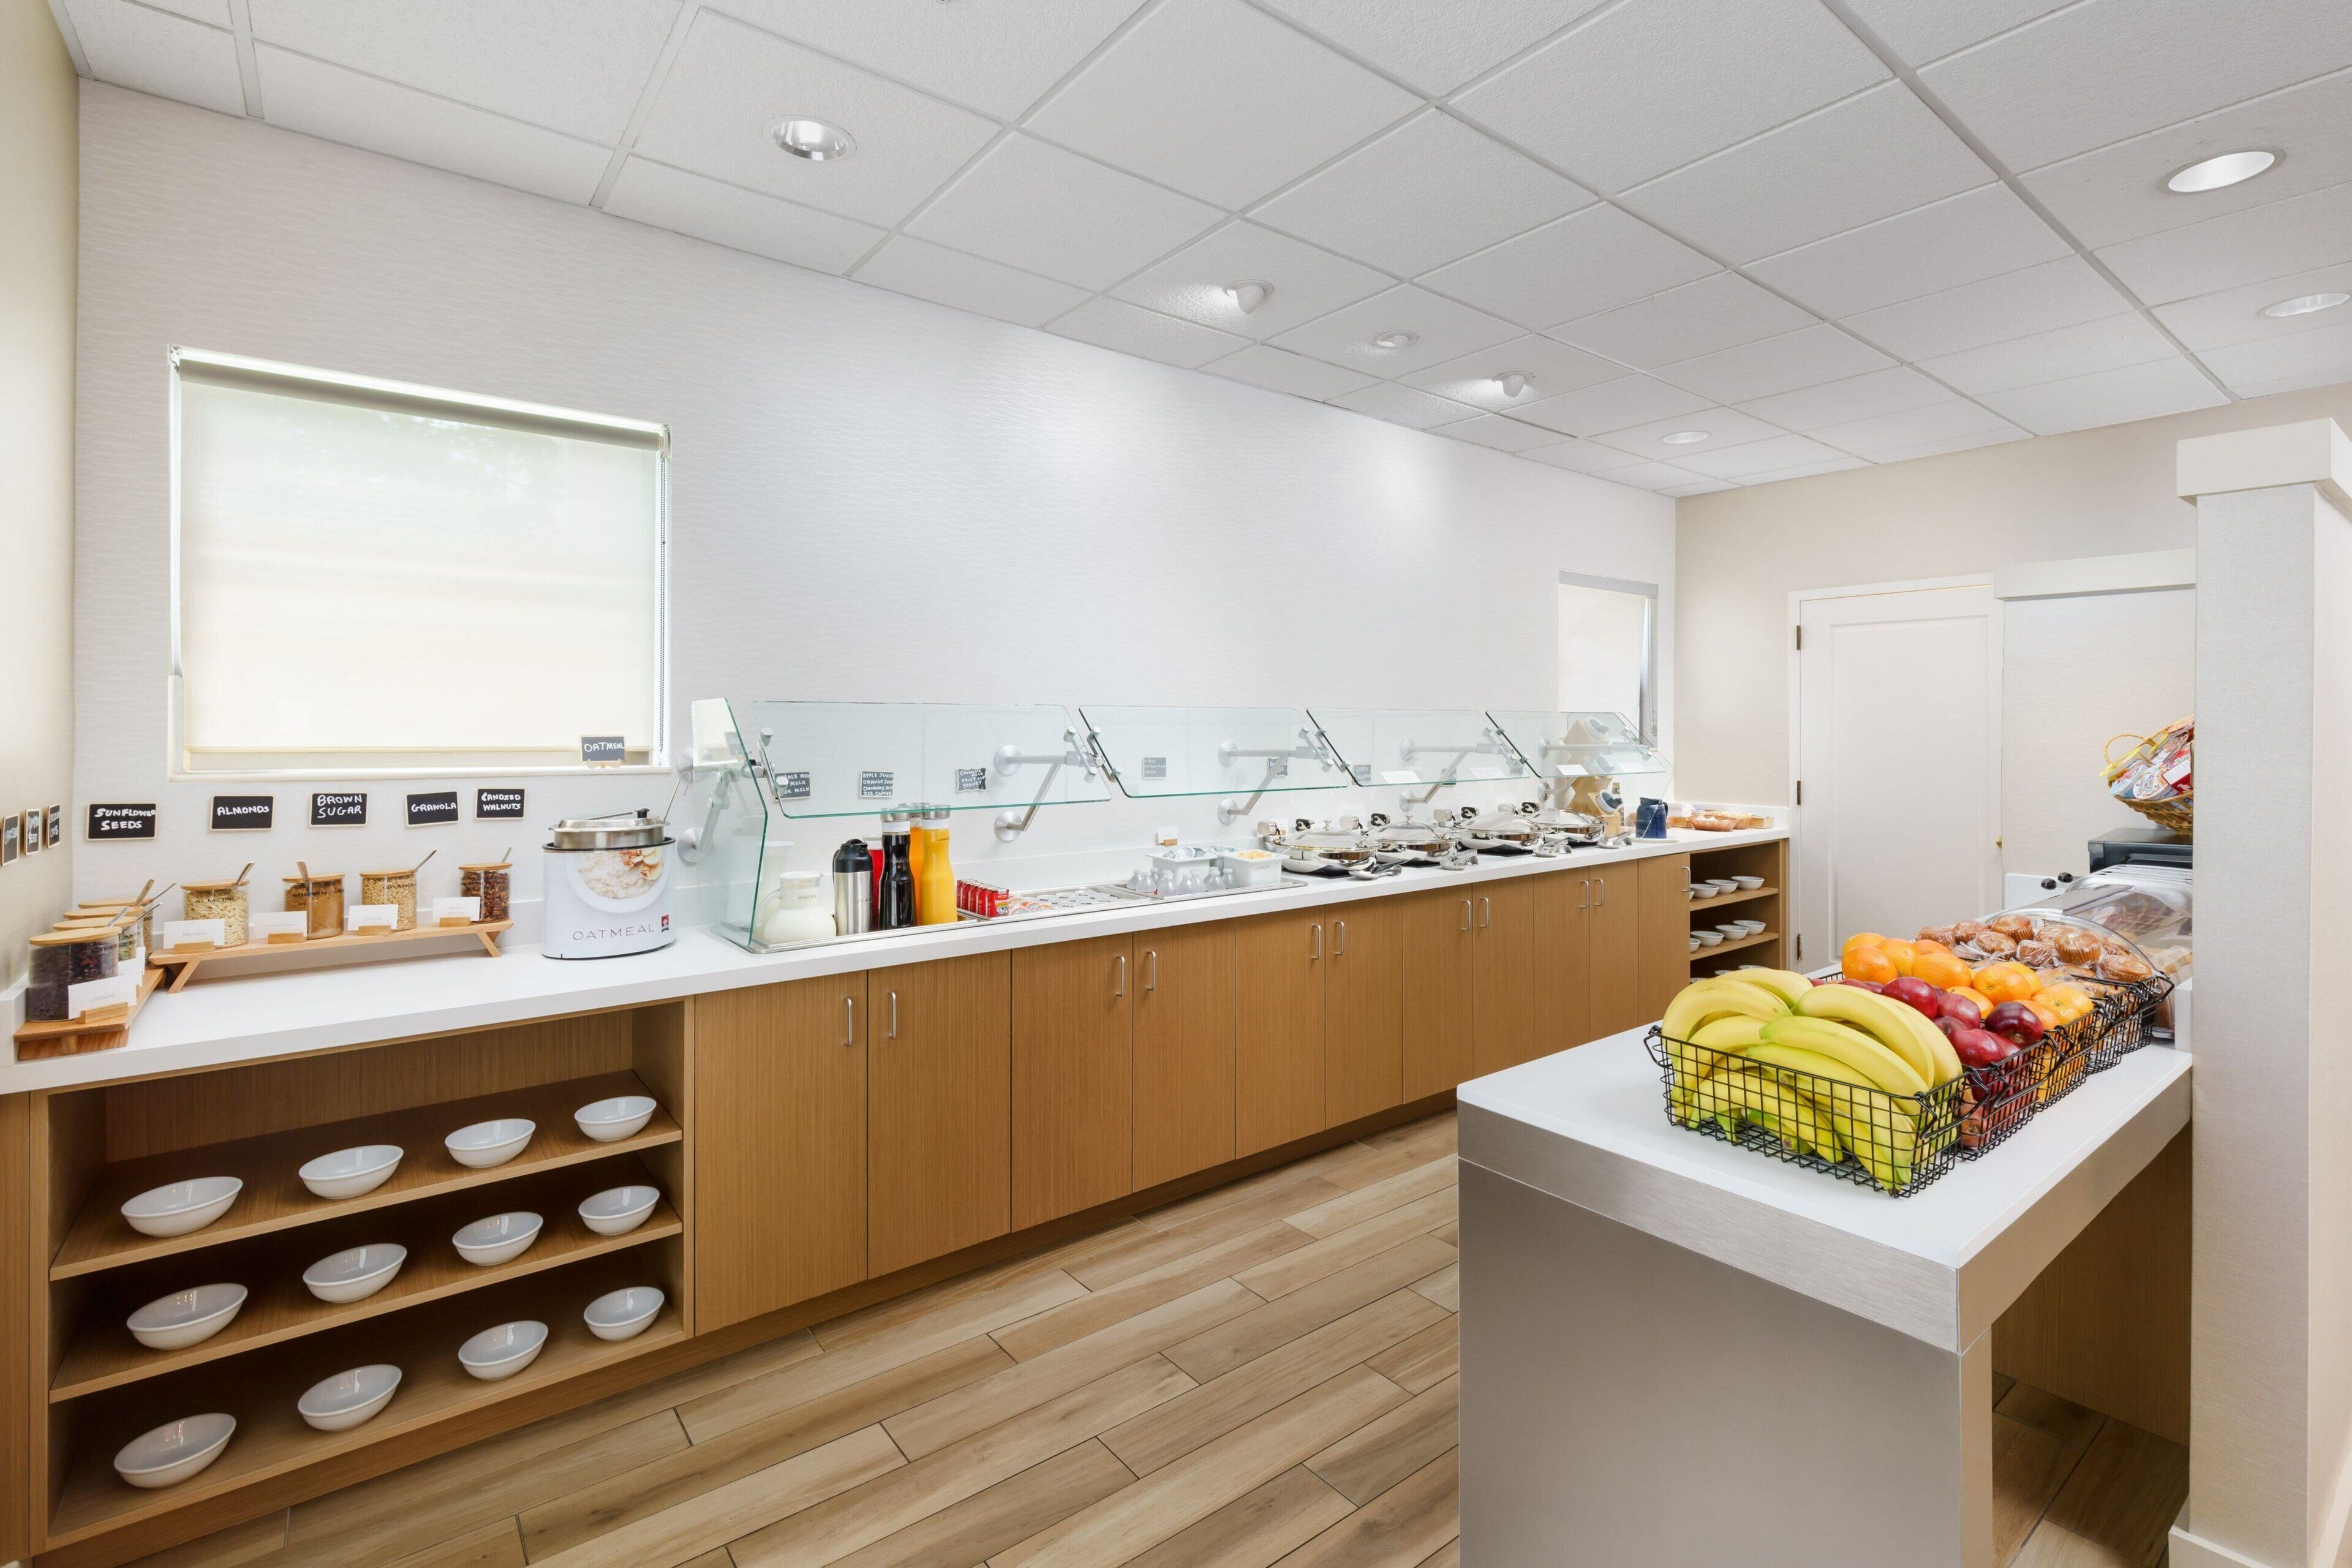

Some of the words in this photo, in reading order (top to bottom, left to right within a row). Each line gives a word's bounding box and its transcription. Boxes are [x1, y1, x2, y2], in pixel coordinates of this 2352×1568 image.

[584, 742, 625, 752] OATMEAL
[963, 780, 982, 789] YOGURT
[317, 794, 363, 807] BROWN
[481, 792, 521, 801] CANDIED
[217, 805, 270, 816] ALMONDS
[317, 805, 362, 818] SUGAR
[411, 802, 457, 812] GRANOLA
[483, 803, 521, 812] WALNUTS
[94, 808, 156, 817] SUNFLOWER
[100, 820, 142, 831] SEEDS
[573, 924, 655, 941] OATMEAL
